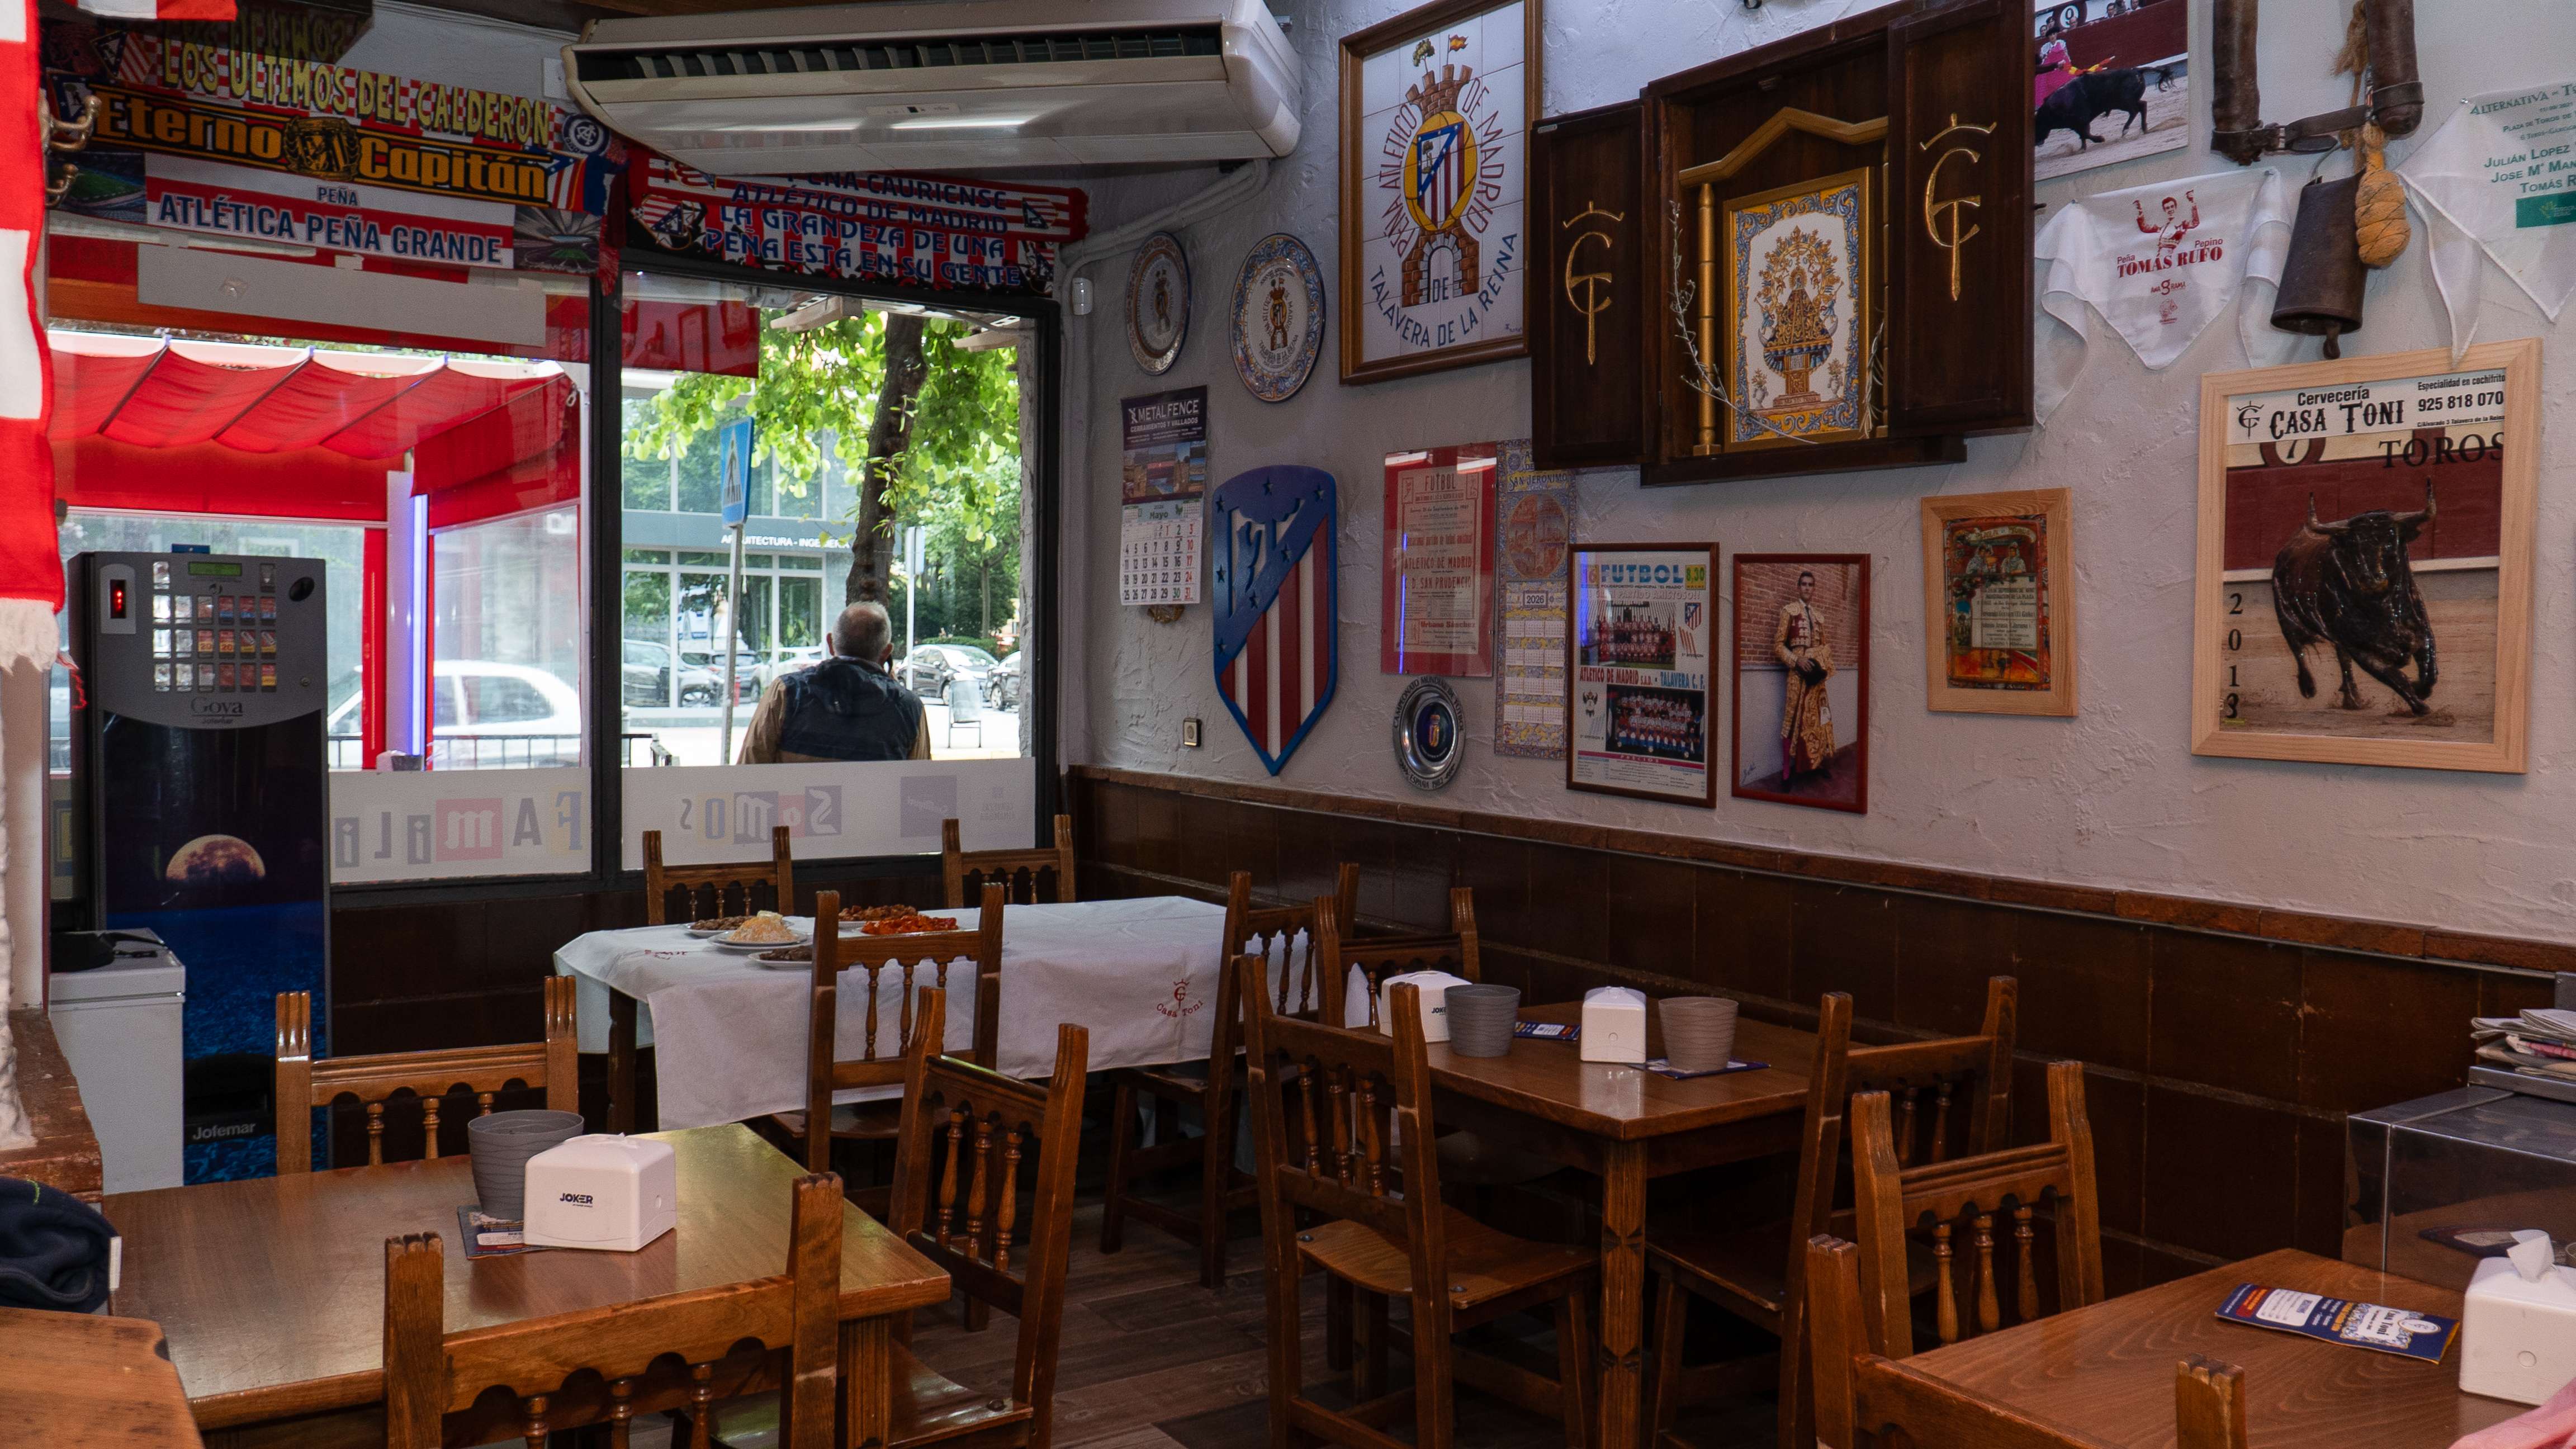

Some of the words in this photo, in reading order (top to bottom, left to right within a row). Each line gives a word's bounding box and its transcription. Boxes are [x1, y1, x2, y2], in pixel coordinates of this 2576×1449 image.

[163, 37, 219, 92] LOS
[230, 49, 349, 112] ULTIMOS
[358, 70, 407, 124] DEL
[416, 82, 552, 147] CALDERON
[1461, 77, 1489, 121] DE
[2470, 91, 2550, 115] ALTERNATIVA
[2535, 116, 2560, 125] TOROS
[94, 90, 282, 159] Eterno
[359, 136, 547, 199] Capitán
[1379, 104, 1417, 189] ATLETICO
[2484, 154, 2526, 168] JULIÁN
[2531, 145, 2570, 160] LOPEZ
[1467, 111, 1504, 233] MADRID
[2491, 170, 2523, 183] JOSE
[318, 186, 358, 206] PEÑA
[867, 174, 1006, 210] CAURIENSE
[2520, 178, 2563, 193] TOMÁS
[731, 183, 858, 216] ATLÉTICO
[868, 200, 899, 221] DE
[908, 204, 1007, 234] MADRID
[159, 194, 295, 238] ATLÉTICA
[307, 215, 380, 252] PEÑA
[392, 226, 501, 263] GRANDE
[720, 205, 752, 226] LA
[762, 209, 905, 247] GRANDEZA
[914, 230, 946, 253] DE
[953, 235, 1005, 258] UNA
[1382, 194, 1415, 257] PEÑA
[2195, 238, 2223, 248] Pepino
[706, 228, 779, 260] PEÑA
[789, 240, 851, 268] ESTÁ
[860, 250, 893, 273] EN
[902, 257, 931, 279] SU
[940, 262, 1021, 285] GENTE
[2117, 254, 2135, 264] Peña
[2117, 255, 2172, 278] TOMÁS
[2177, 247, 2223, 267] RUFO
[1370, 265, 1430, 348] TALAVERA
[1438, 320, 1455, 347] DE
[1460, 307, 1479, 335] LA
[1478, 233, 1517, 311] REINA
[1432, 277, 1448, 303] DE
[2418, 378, 2460, 391] Especialidad
[2472, 374, 2506, 385] cochifrito
[2298, 385, 2370, 406] Cervecería
[2418, 397, 2443, 411] 925
[2447, 394, 2473, 409] 818
[2478, 391, 2504, 406] 070
[2270, 408, 2327, 439] CASA
[2339, 400, 2405, 433] TONI
[2379, 432, 2504, 468] TOROS
[1149, 512, 1168, 520] Mayo
[1166, 525, 1169, 536] 1
[1177, 525, 1181, 535] 2
[1190, 524, 1193, 534] 3
[1125, 544, 1129, 554] 4
[1134, 543, 1138, 553] 5
[1144, 543, 1147, 553] 6
[1153, 542, 1157, 552] 7
[1164, 541, 1168, 551] 8
[1176, 541, 1180, 551] 9
[1187, 539, 1194, 550] 10
[1125, 560, 1129, 570] 11
[1133, 559, 1138, 569] 12
[1143, 558, 1147, 568] 13
[1152, 557, 1157, 567] 14
[1163, 556, 1168, 567] 15
[1175, 556, 1181, 566] 16
[1187, 555, 1192, 566] 17
[1124, 575, 1129, 585] 18
[1133, 574, 1138, 584] 19
[1142, 574, 1148, 584] 20
[1152, 573, 1157, 583] 21
[1162, 572, 1168, 583] 22
[1174, 572, 1181, 582] 23
[1185, 571, 1192, 582] 24
[1601, 564, 1684, 584] FUTBOL
[1685, 566, 1705, 583] 8,30
[1124, 590, 1129, 600] 25
[1133, 589, 1138, 599] 26
[1141, 589, 1147, 599] 27
[1151, 589, 1157, 599] 28
[1161, 588, 1168, 599] 29
[1173, 588, 1181, 598] 30
[1185, 588, 1191, 599] 31
[1527, 595, 1545, 604] 2026
[1580, 666, 1604, 682] ATLETICO
[1607, 667, 1614, 683] DE
[1616, 667, 1639, 684] MADRID
[1660, 671, 1690, 688] TALAVERA
[190, 697, 243, 714] Goya
[192, 1123, 257, 1140] Jofemar
[560, 1193, 593, 1204] JOKER
